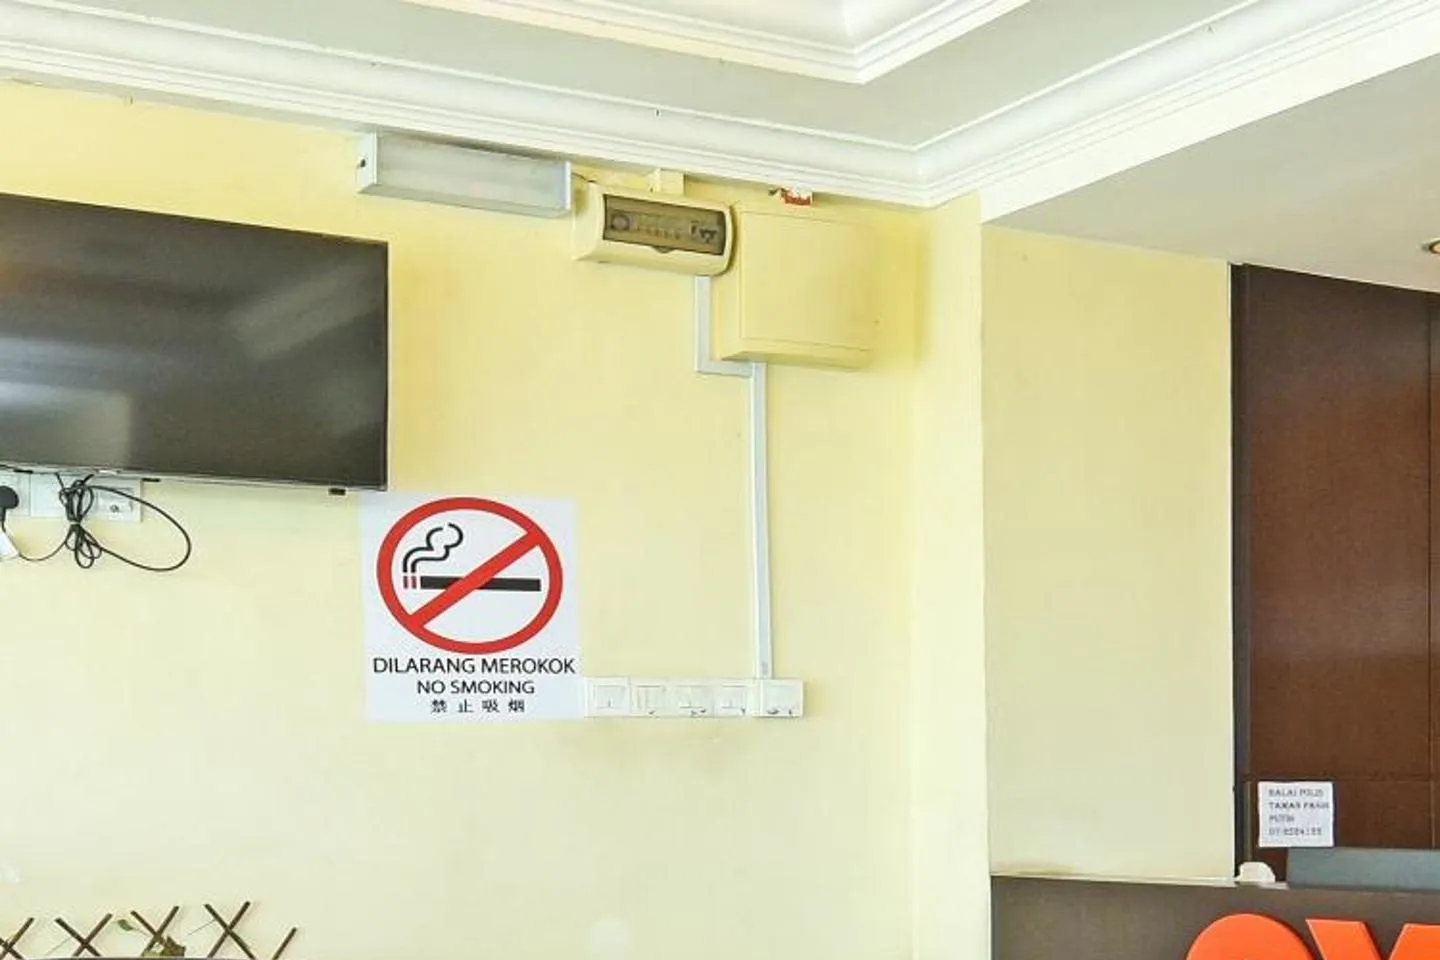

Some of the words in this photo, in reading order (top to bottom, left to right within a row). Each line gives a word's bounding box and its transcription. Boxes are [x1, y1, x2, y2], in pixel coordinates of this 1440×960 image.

[373, 657, 476, 674] DILARANG
[481, 657, 576, 674] MEROKOK
[417, 679, 446, 694] NO
[450, 679, 535, 694] SMOKING
[431, 699, 525, 713] 禁止吸烟
